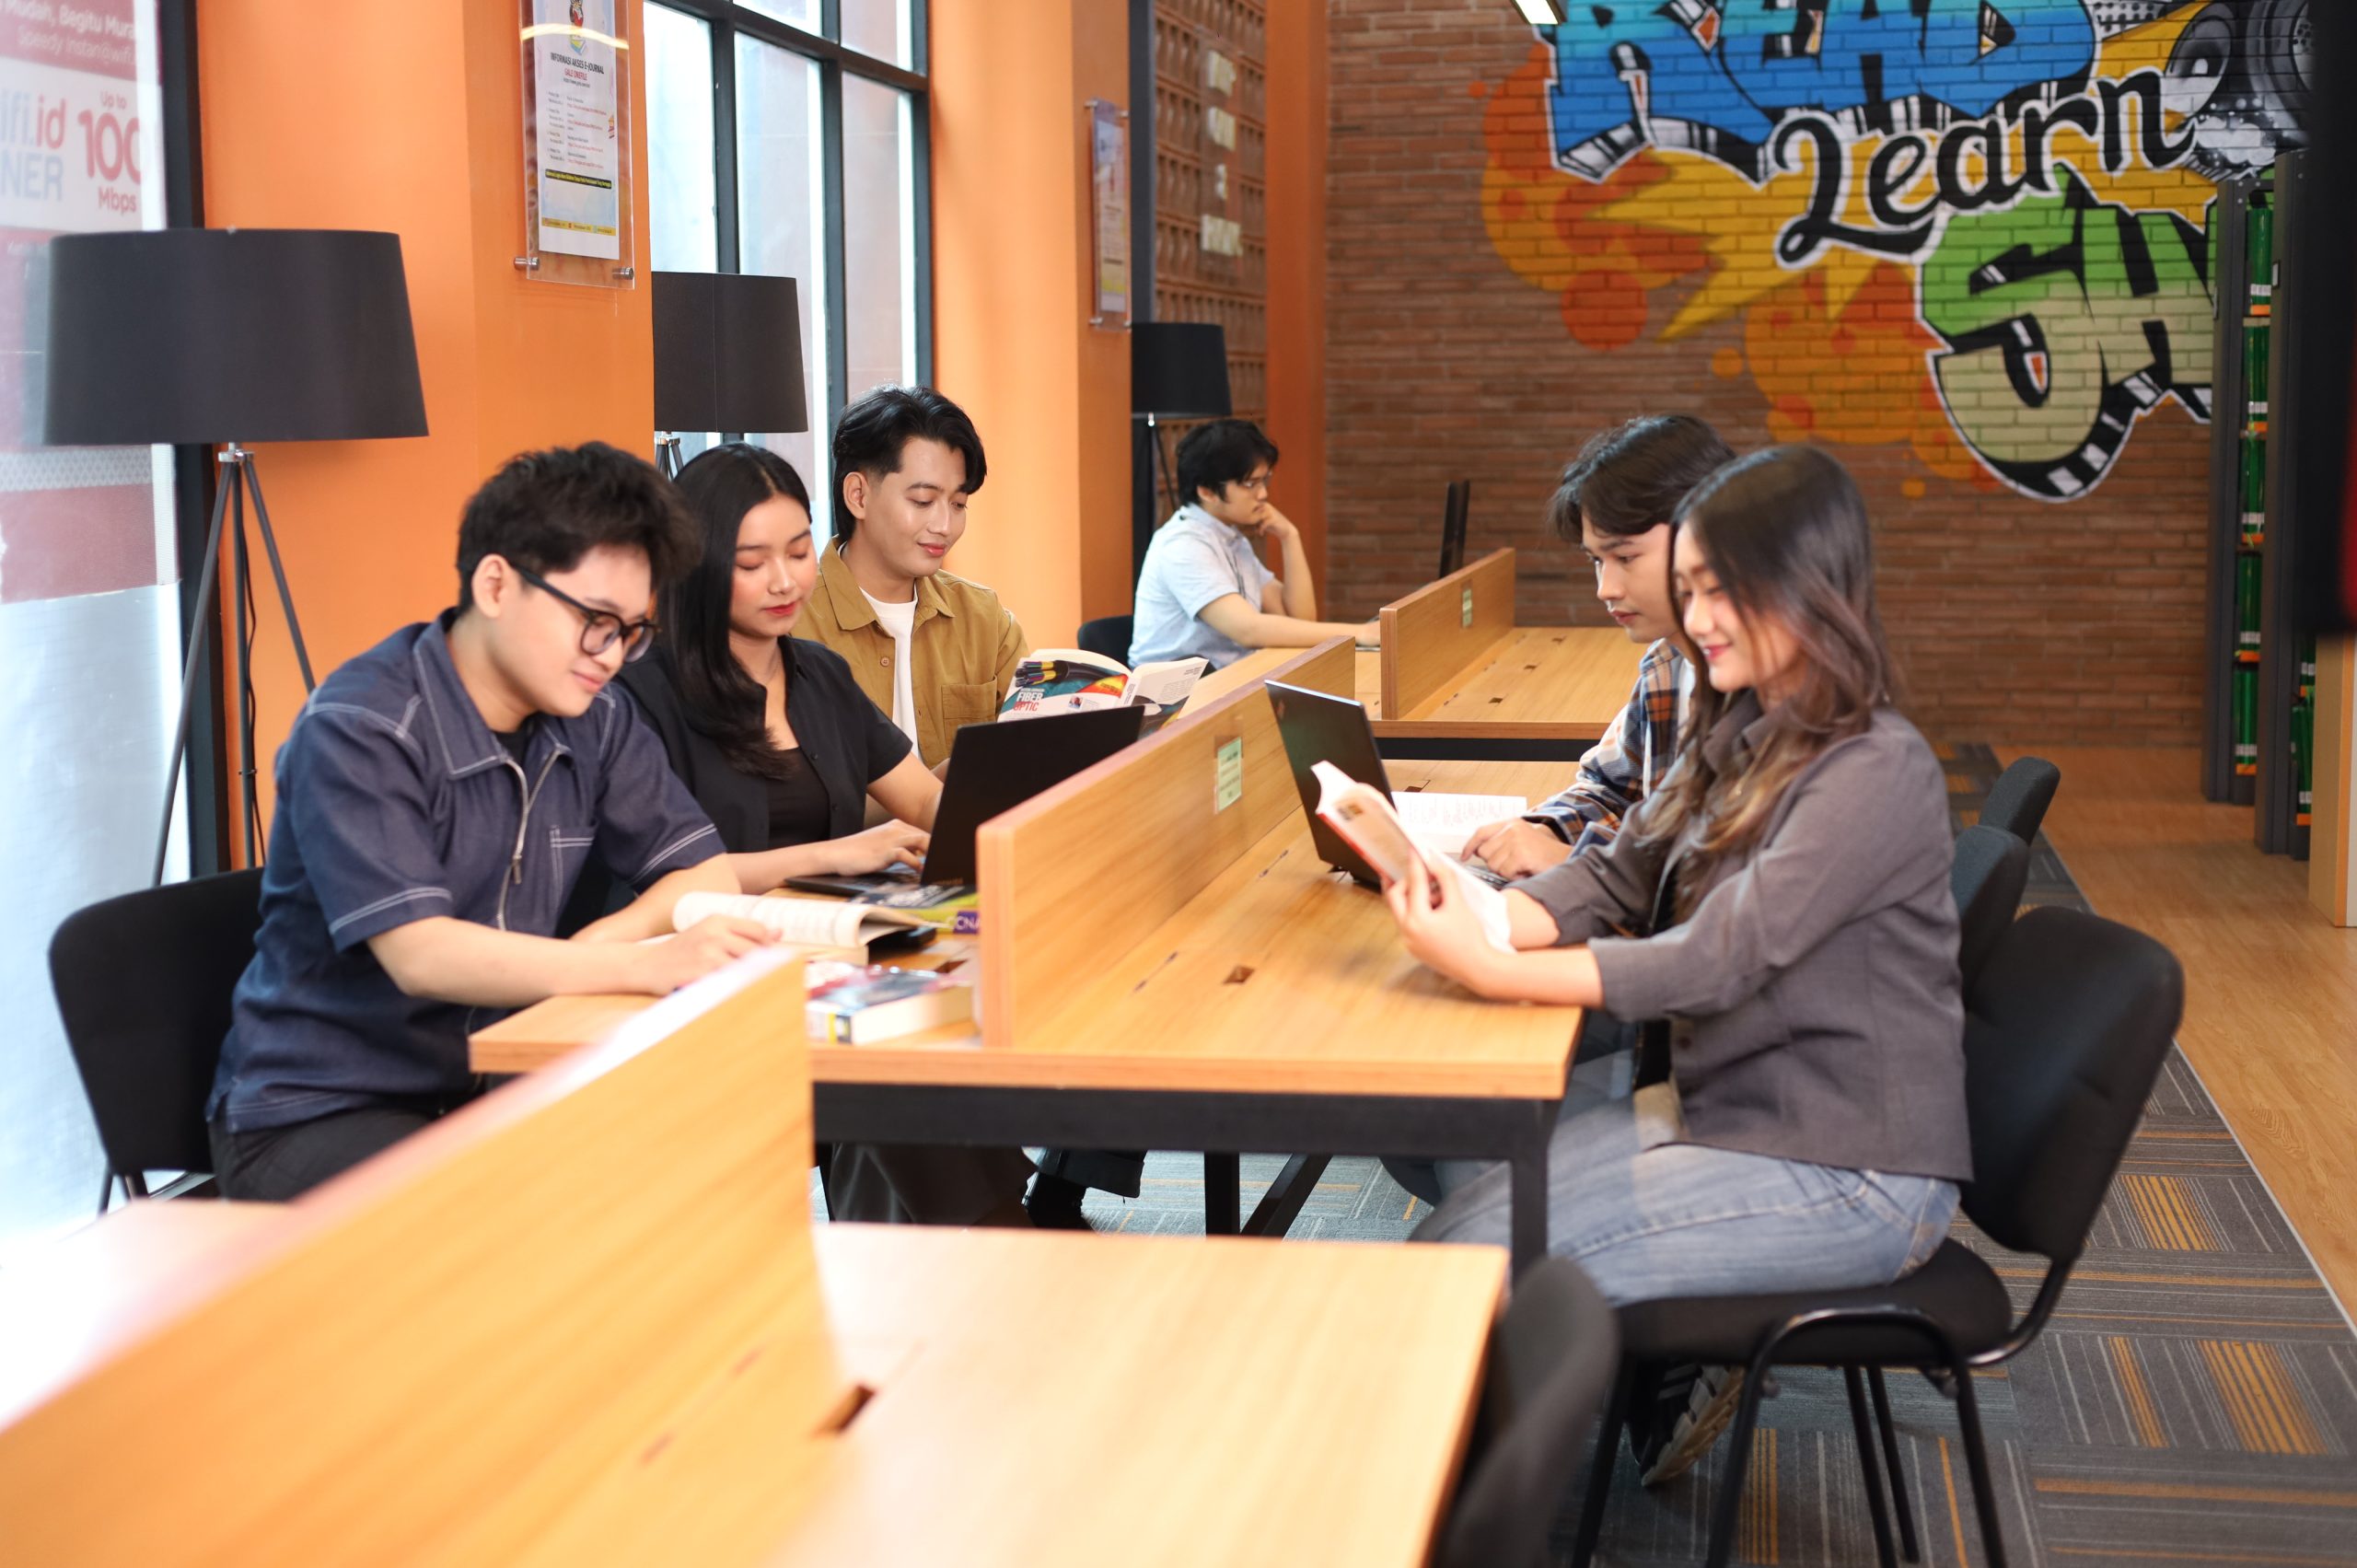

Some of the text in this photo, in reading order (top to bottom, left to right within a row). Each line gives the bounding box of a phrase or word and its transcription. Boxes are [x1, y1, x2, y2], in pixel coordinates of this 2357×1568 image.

[59, 4, 102, 33] Begitu
[99, 91, 127, 110] Up to
[1773, 64, 2202, 270] Learn
[98, 186, 137, 215] Mbps
[1919, 166, 2217, 500] SH
[1014, 701, 1039, 713] OPTIC
[1016, 691, 1044, 703] FIBER
